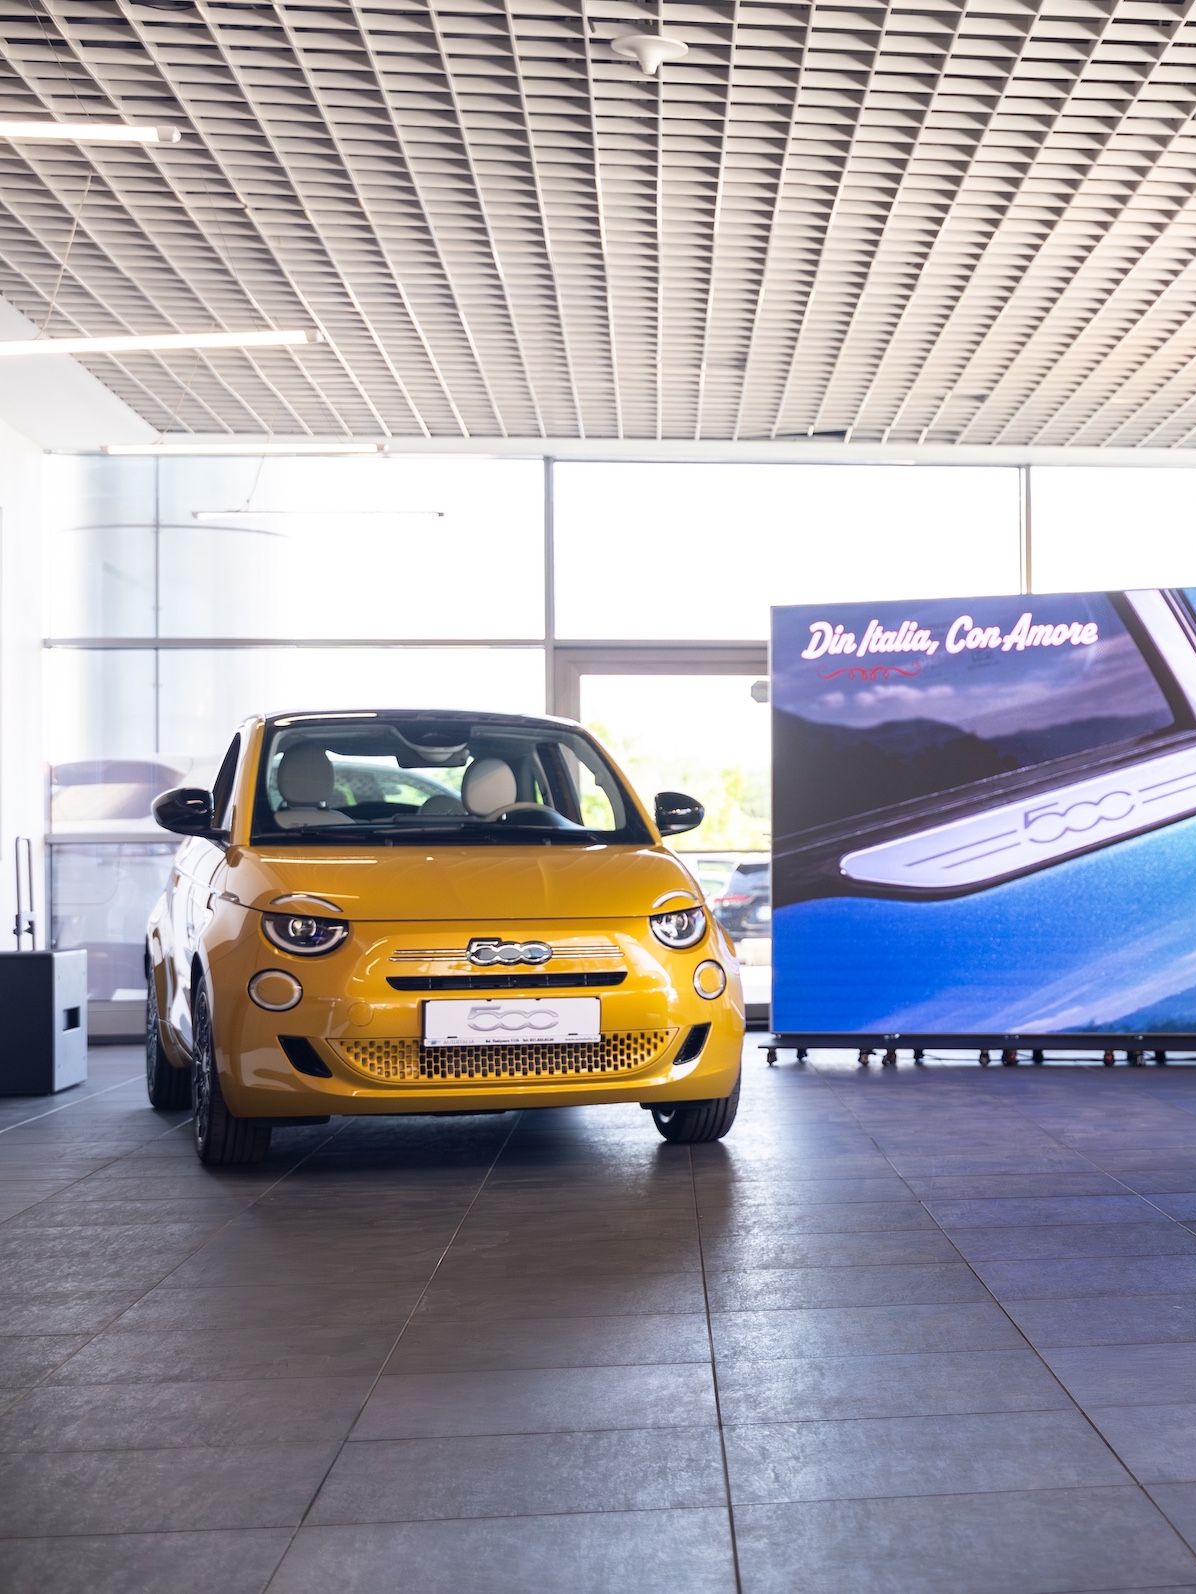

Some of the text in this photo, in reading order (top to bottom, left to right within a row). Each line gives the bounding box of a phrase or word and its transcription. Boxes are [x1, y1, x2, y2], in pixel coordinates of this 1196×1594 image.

[801, 612, 1099, 659] Din Italia, Con Amore
[1023, 791, 1135, 843] 500
[467, 938, 552, 966] 500
[467, 1005, 559, 1031] 500
